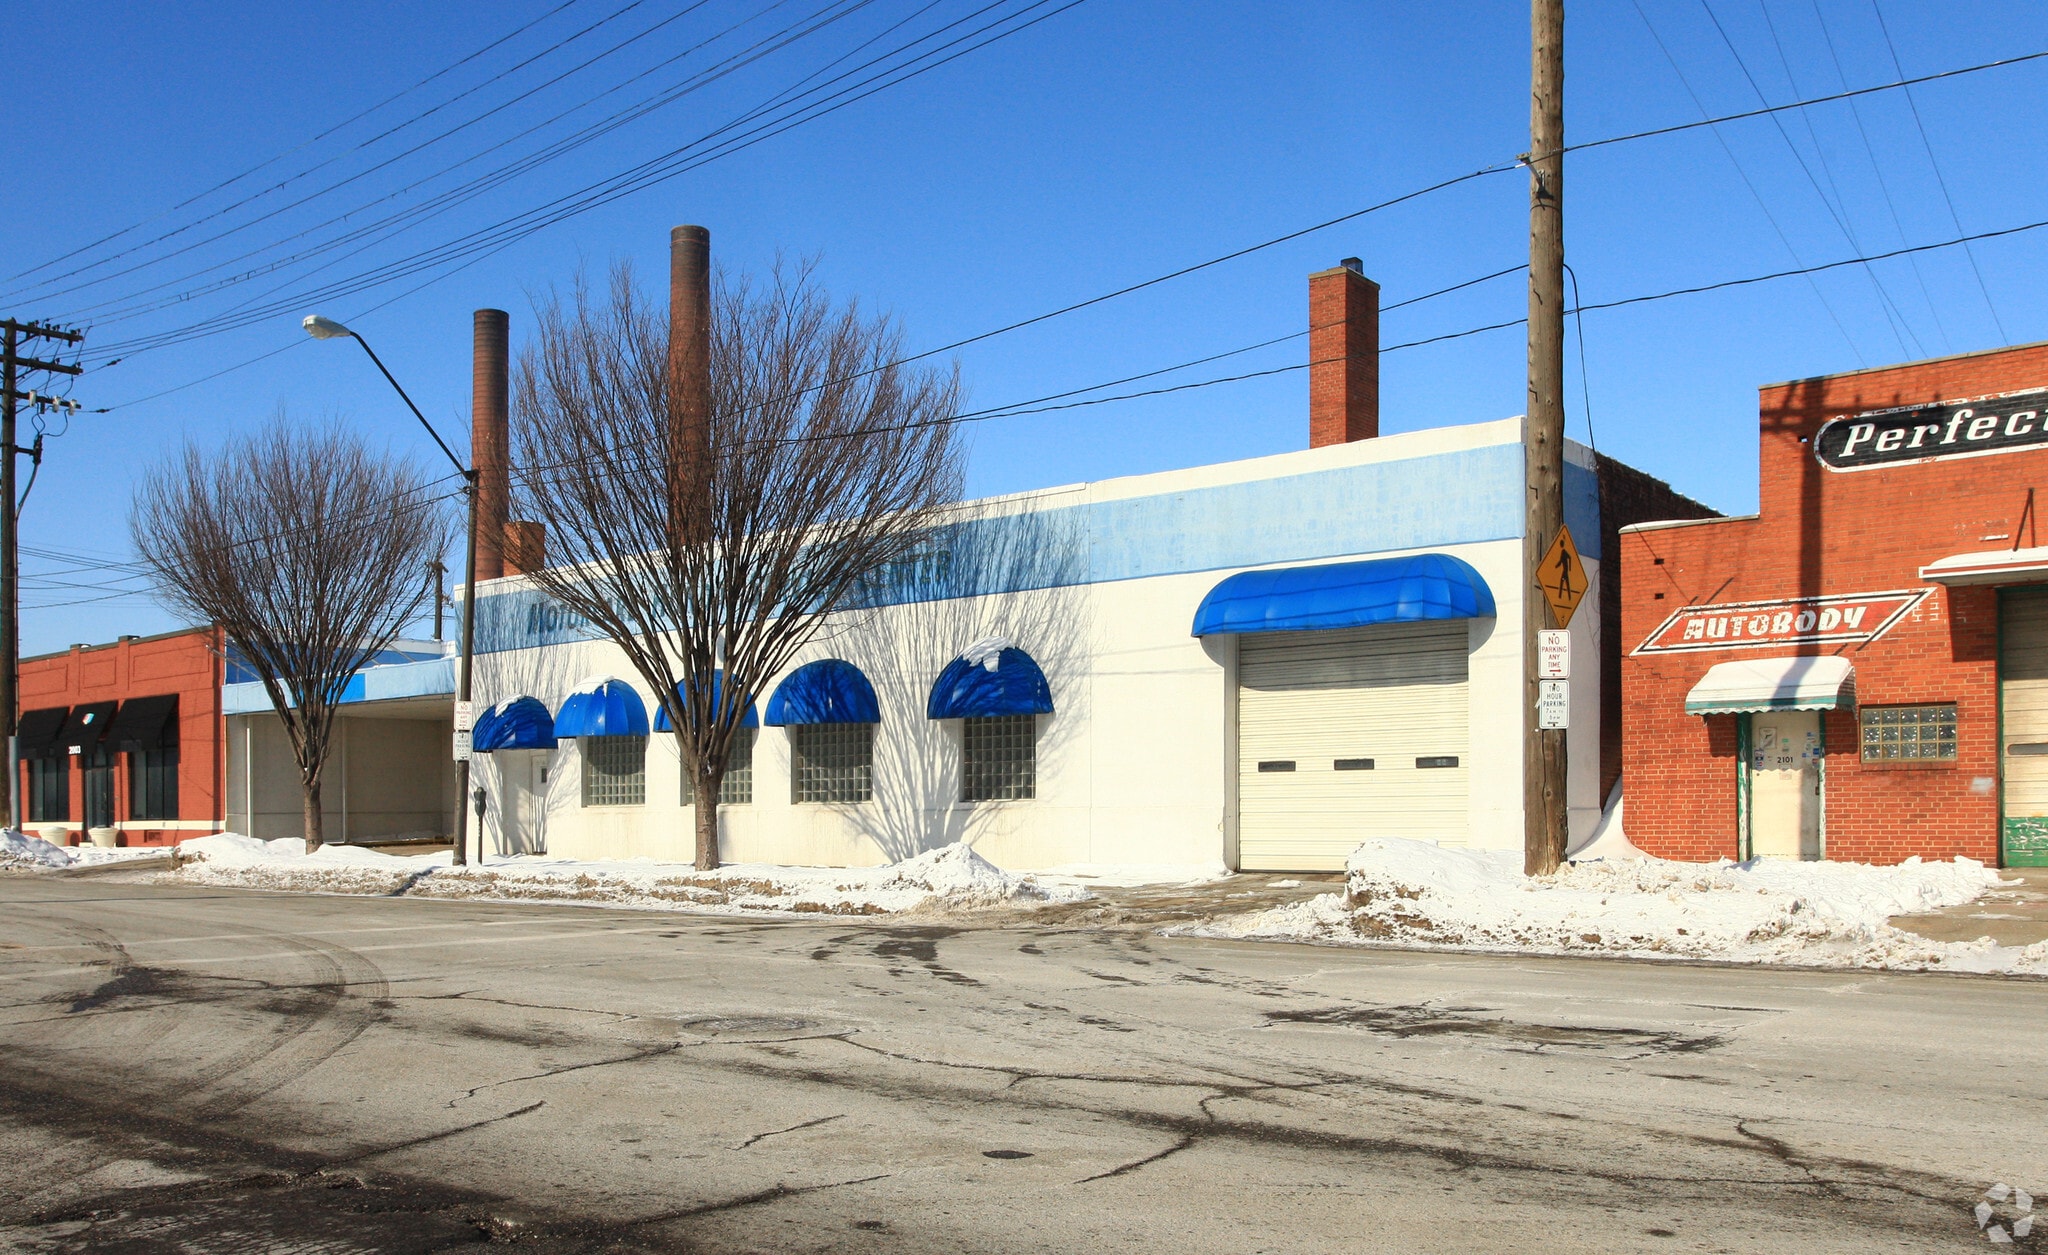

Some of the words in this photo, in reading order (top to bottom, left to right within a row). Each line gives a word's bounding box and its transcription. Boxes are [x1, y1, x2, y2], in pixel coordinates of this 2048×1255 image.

[1683, 606, 1867, 640] AUTOBODY
[1548, 636, 1560, 645] NO
[1541, 645, 1567, 653] PARKING
[1548, 653, 1561, 661] ANY
[1546, 692, 1563, 700] HOUR
[1777, 756, 1794, 764] 2101
